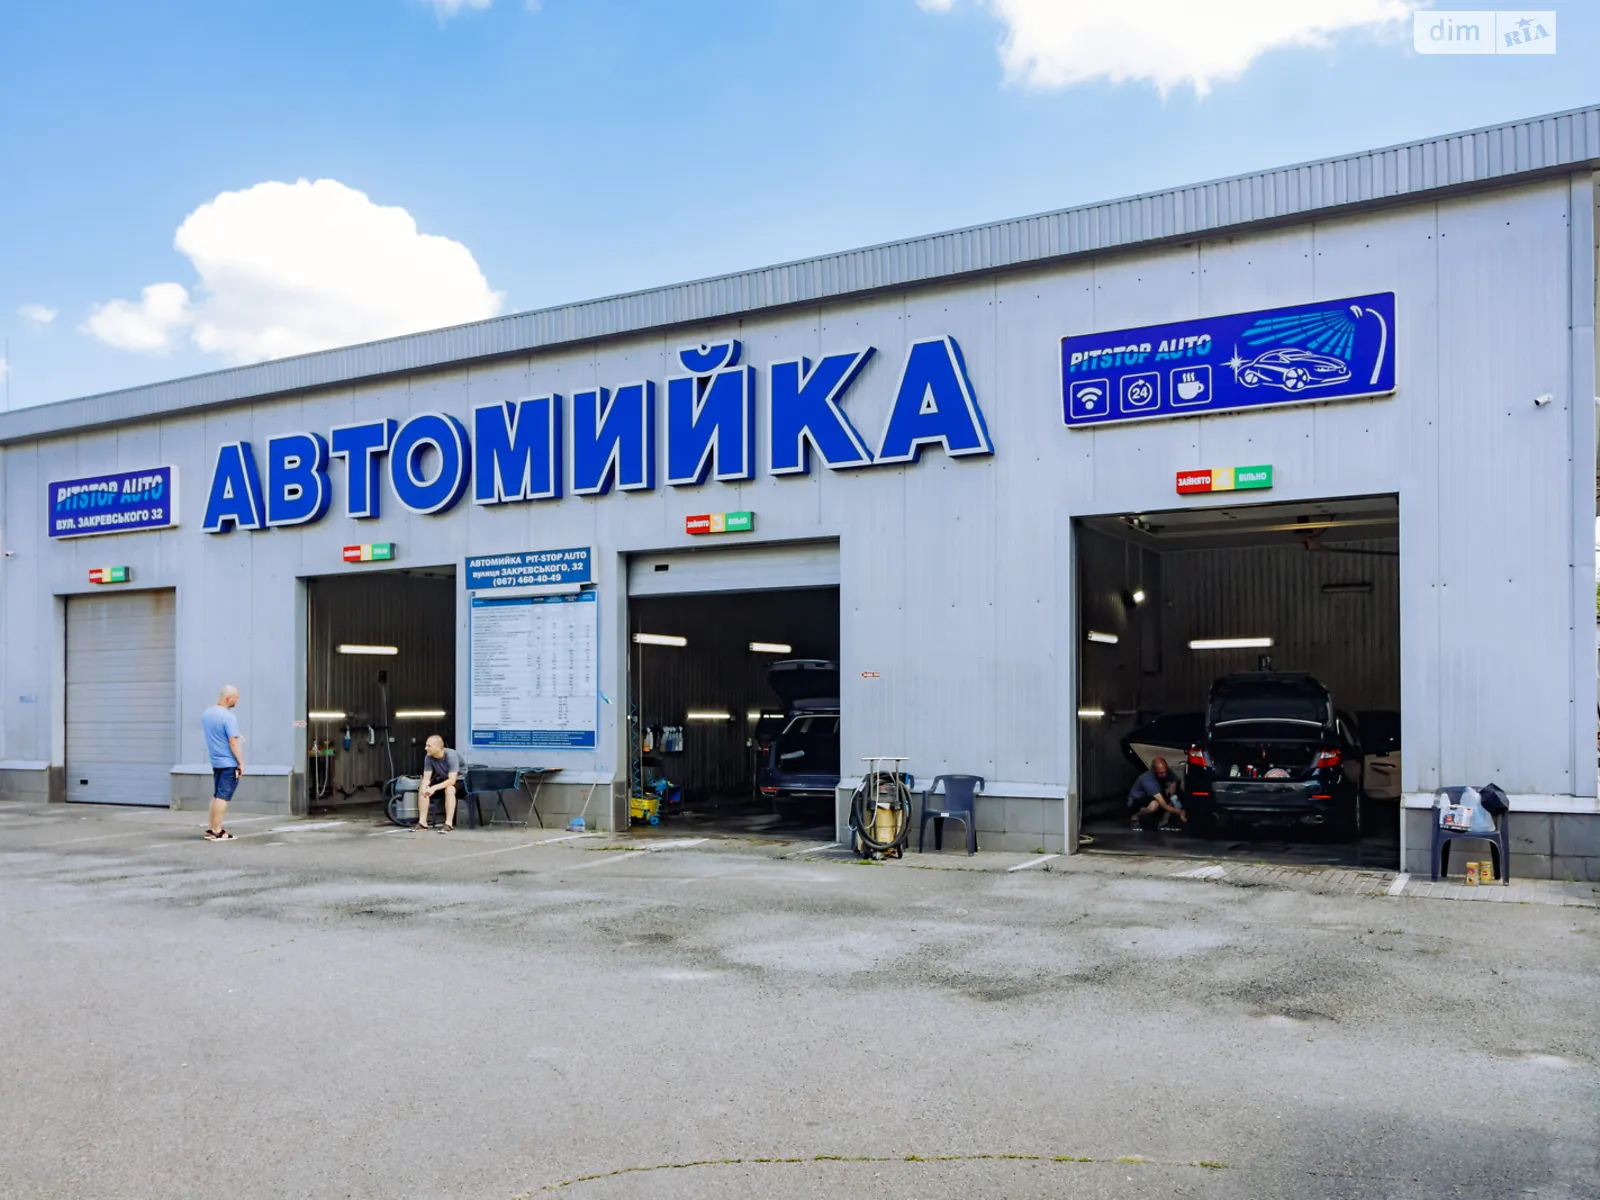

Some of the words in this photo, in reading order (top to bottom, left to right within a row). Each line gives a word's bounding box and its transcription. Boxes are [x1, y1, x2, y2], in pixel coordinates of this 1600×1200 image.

[1070, 342, 1151, 372] PITSTOP
[1155, 334, 1212, 361] AUTO
[1131, 386, 1148, 399] 24
[202, 335, 994, 534] АВТОМИЙКА
[1215, 470, 1230, 488] 4
[56, 481, 118, 511] PITSTOP
[120, 474, 163, 503] AUTO
[56, 518, 76, 530] ВУЛ.
[78, 509, 149, 528] ЗАКРЕВСЬКОГО
[151, 508, 163, 520] 32
[713, 515, 723, 530] 3
[470, 556, 521, 568] АВТОМИЙКА
[526, 553, 563, 563] PIT-STOP
[564, 551, 587, 560] AUTO
[472, 570, 500, 578] вулиця
[501, 564, 570, 576] ЗАКРЕВСЬКОГО,
[572, 562, 584, 570] 32
[493, 577, 516, 587] (067)
[517, 574, 561, 584] 460-40-49
